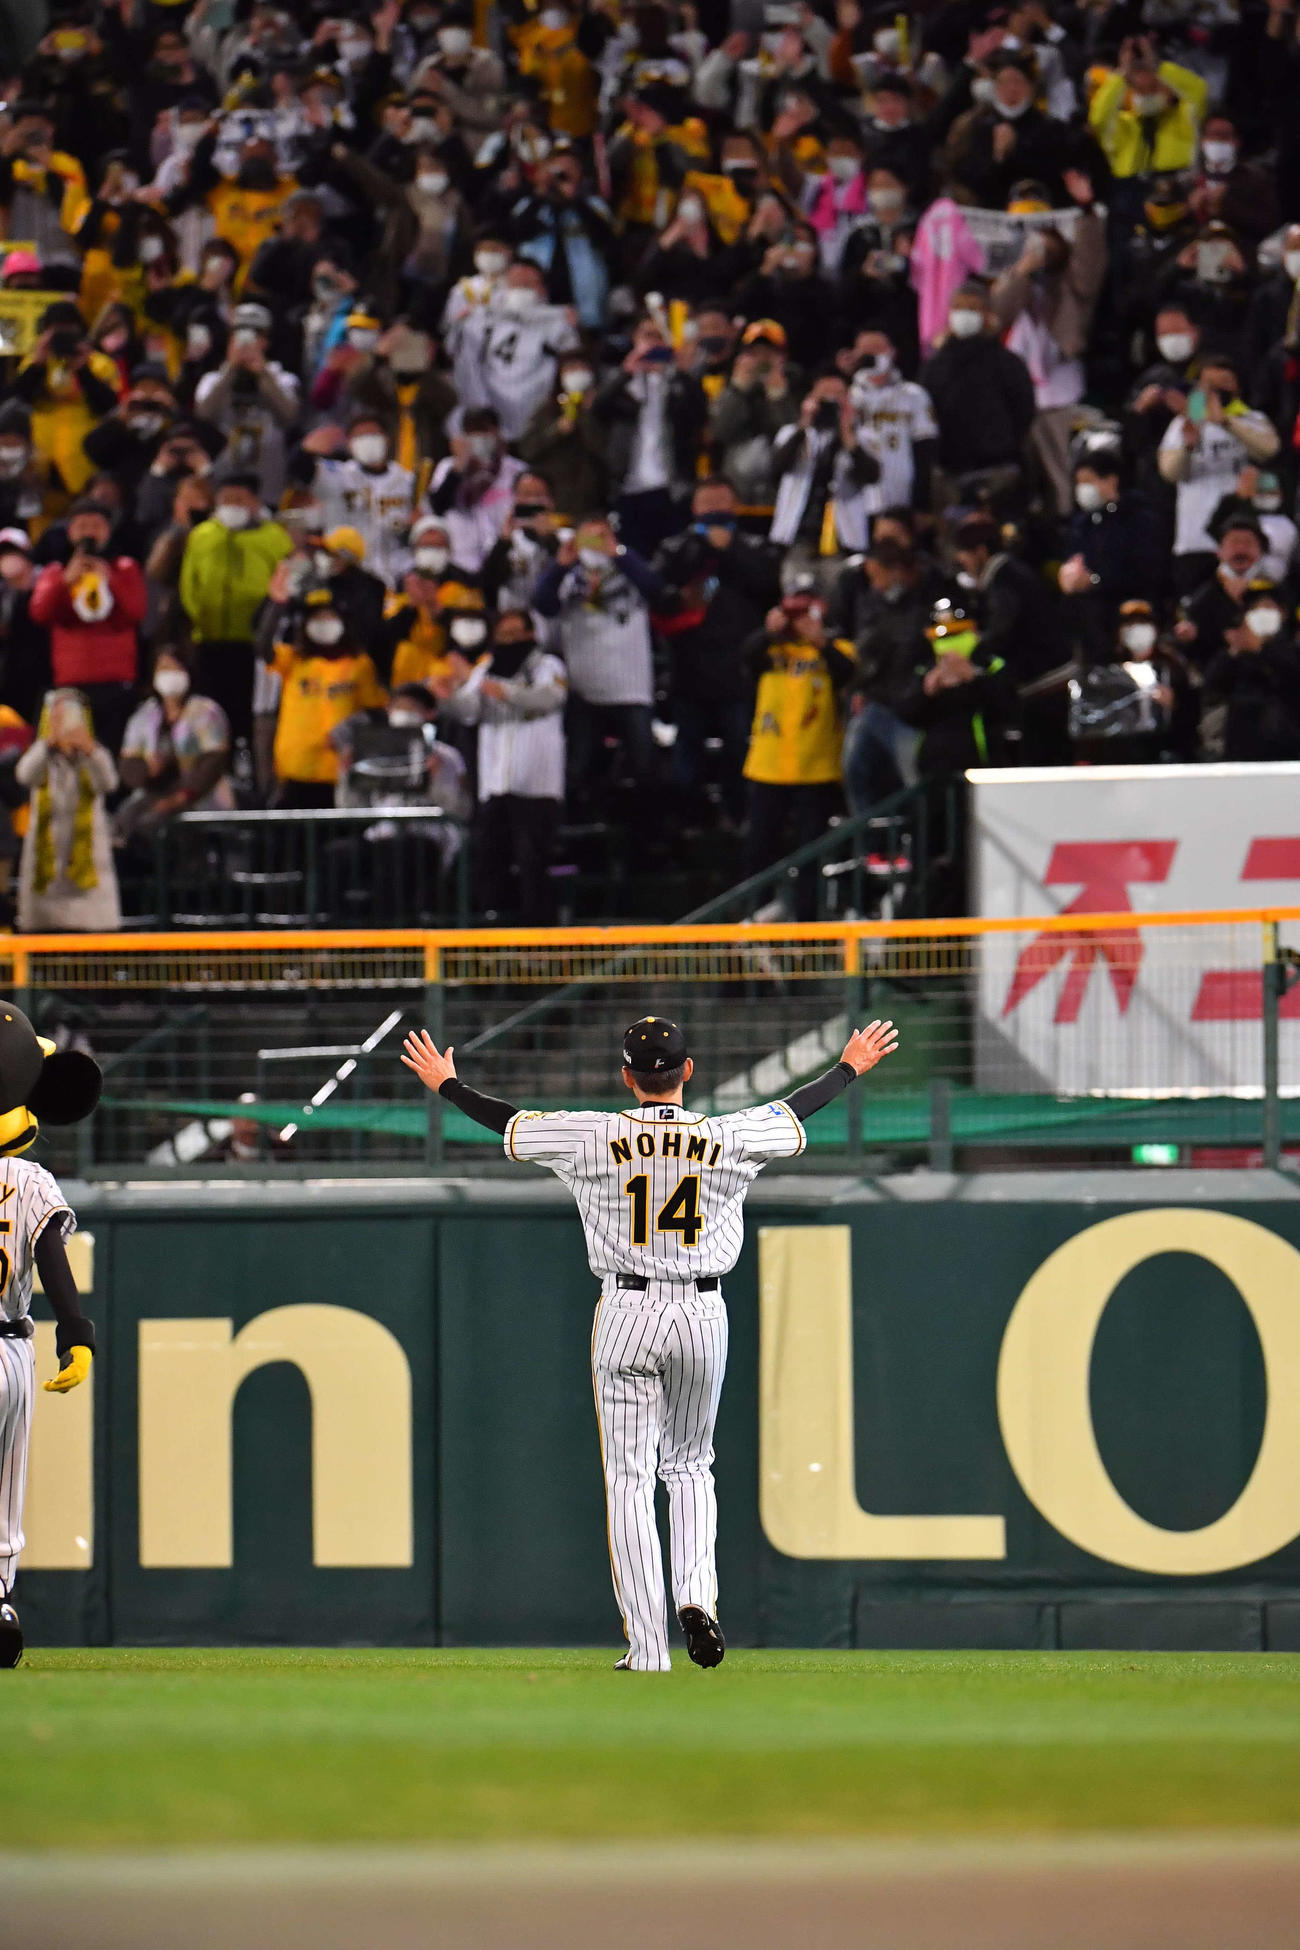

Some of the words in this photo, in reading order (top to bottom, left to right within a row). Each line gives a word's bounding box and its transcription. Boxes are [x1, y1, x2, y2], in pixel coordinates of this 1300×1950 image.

[609, 1132, 722, 1168] NOHMI
[625, 1174, 703, 1247] 14
[758, 1208, 1300, 1576] LO
